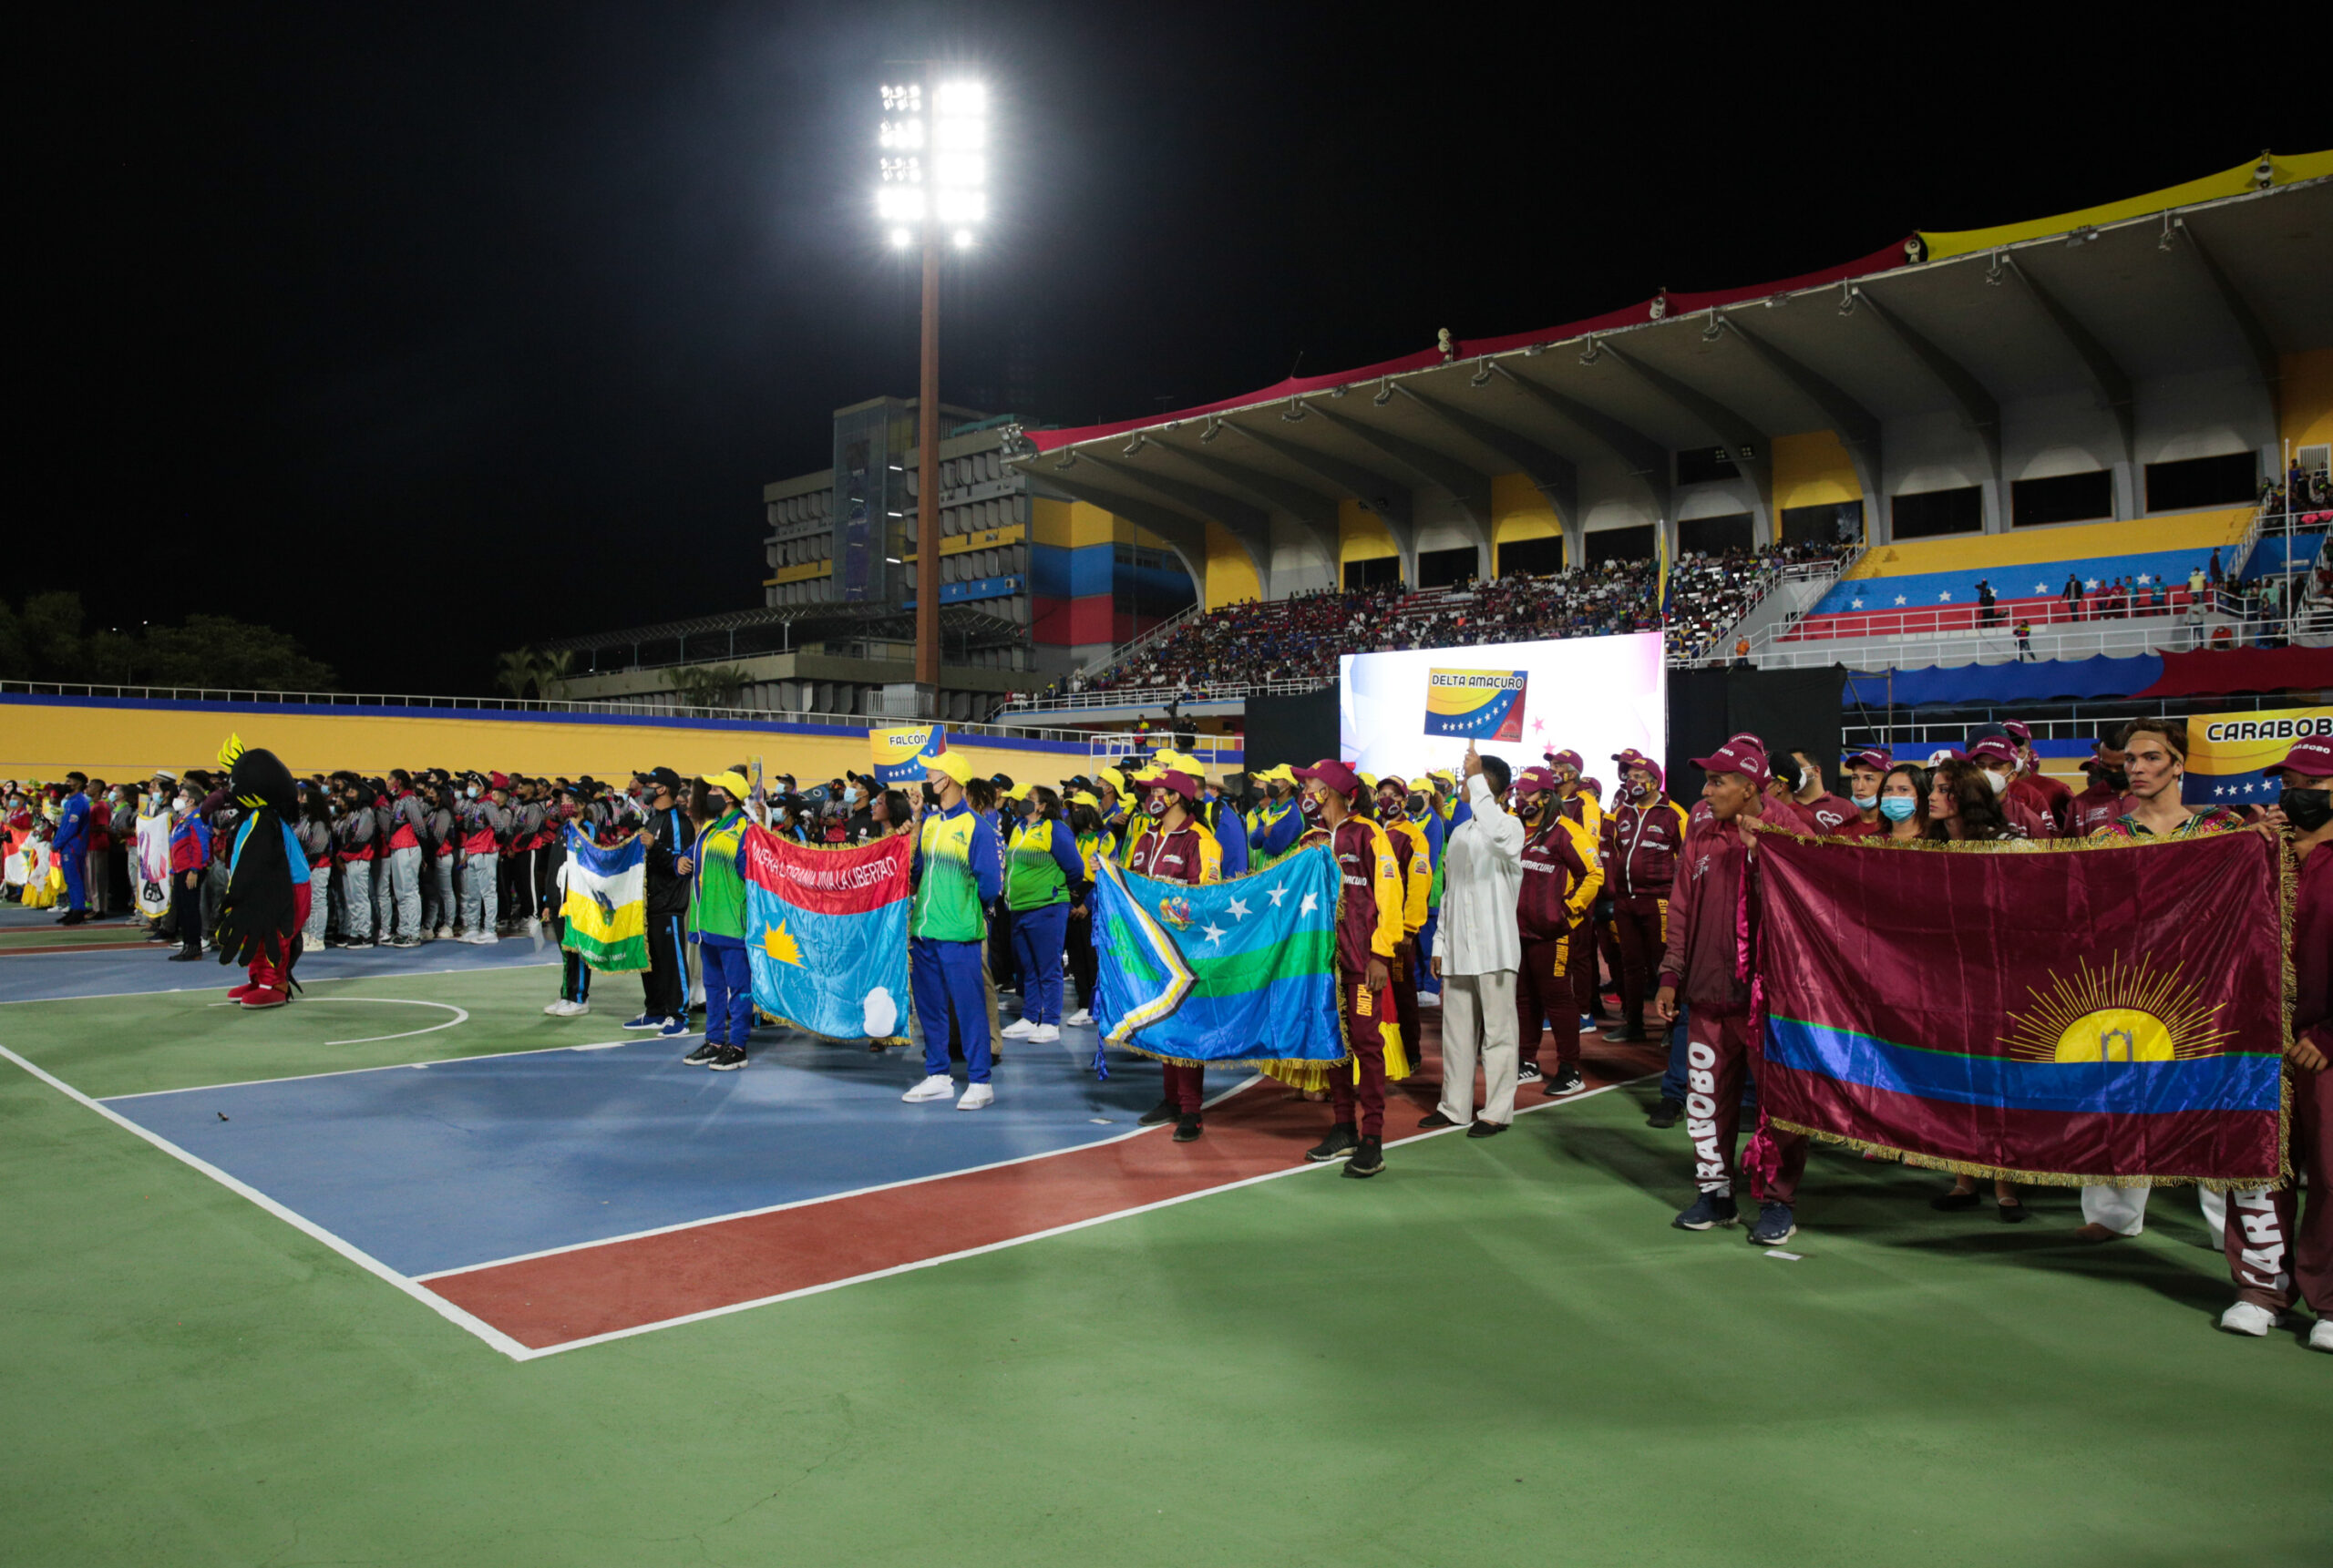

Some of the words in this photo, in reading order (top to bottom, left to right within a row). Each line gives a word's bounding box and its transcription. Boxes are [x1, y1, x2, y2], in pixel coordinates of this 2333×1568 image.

[1432, 674, 1466, 686] DELTA
[1468, 675, 1524, 689] AMACURO
[889, 729, 928, 746] FALCÓN
[848, 856, 898, 889] LIBERTAD
